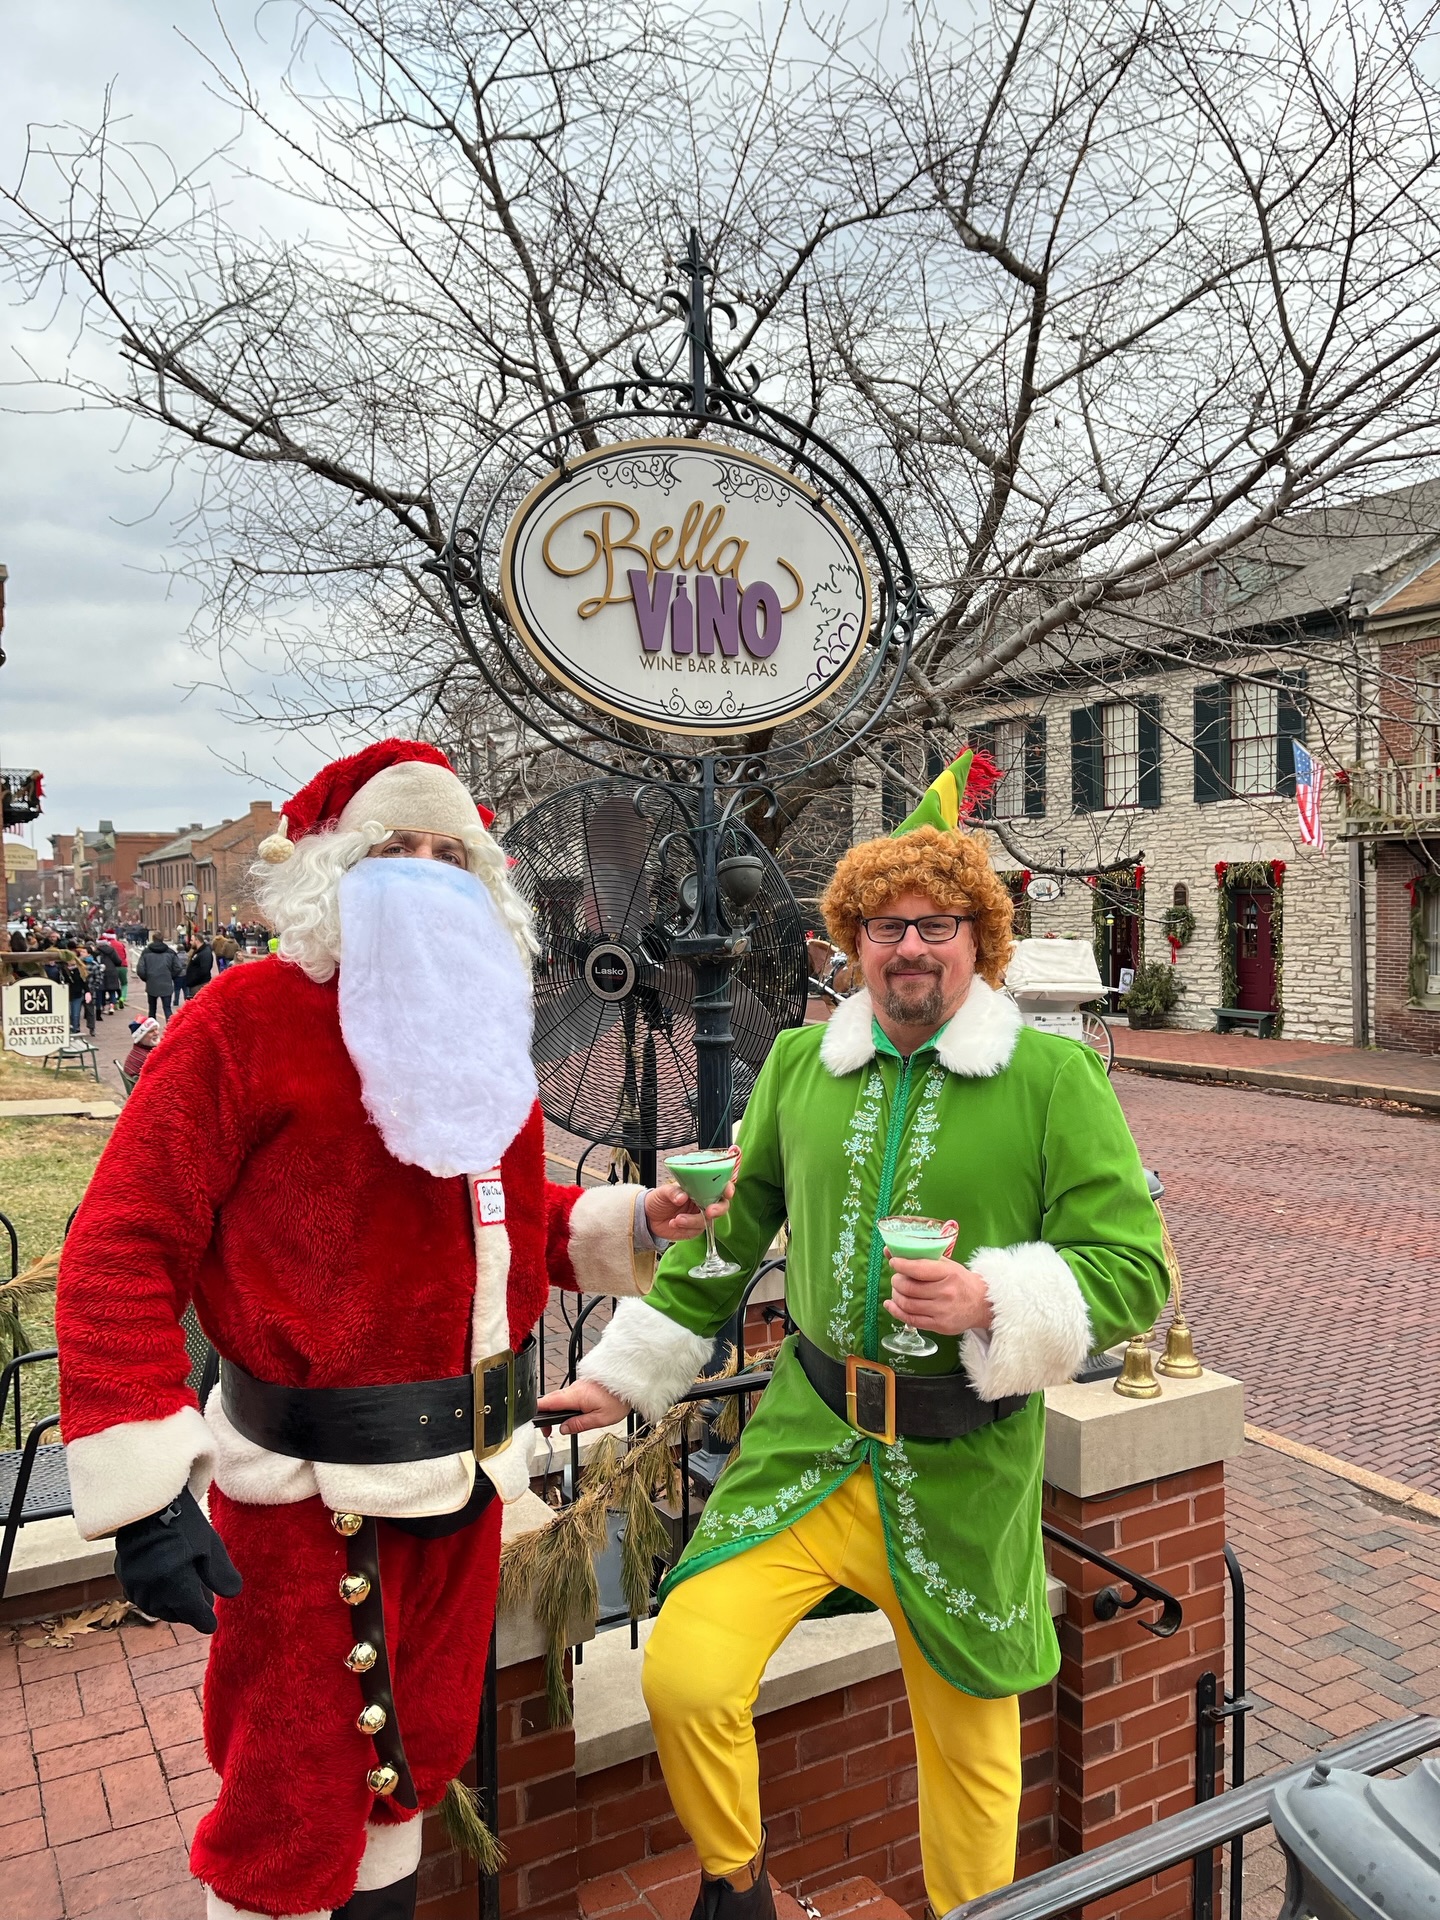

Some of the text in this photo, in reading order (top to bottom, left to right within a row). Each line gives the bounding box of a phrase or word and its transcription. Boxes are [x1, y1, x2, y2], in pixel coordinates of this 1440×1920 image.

[542, 500, 804, 618] Bella
[639, 655, 778, 677] WINE BAR & TAPAS
[595, 966, 624, 975] Lasko
[24, 989, 48, 1000] MA
[24, 1000, 49, 1011] OM
[8, 1015, 65, 1026] MISSOURI
[8, 1026, 65, 1036] ARTISTS
[8, 1036, 65, 1046] ON MAIN
